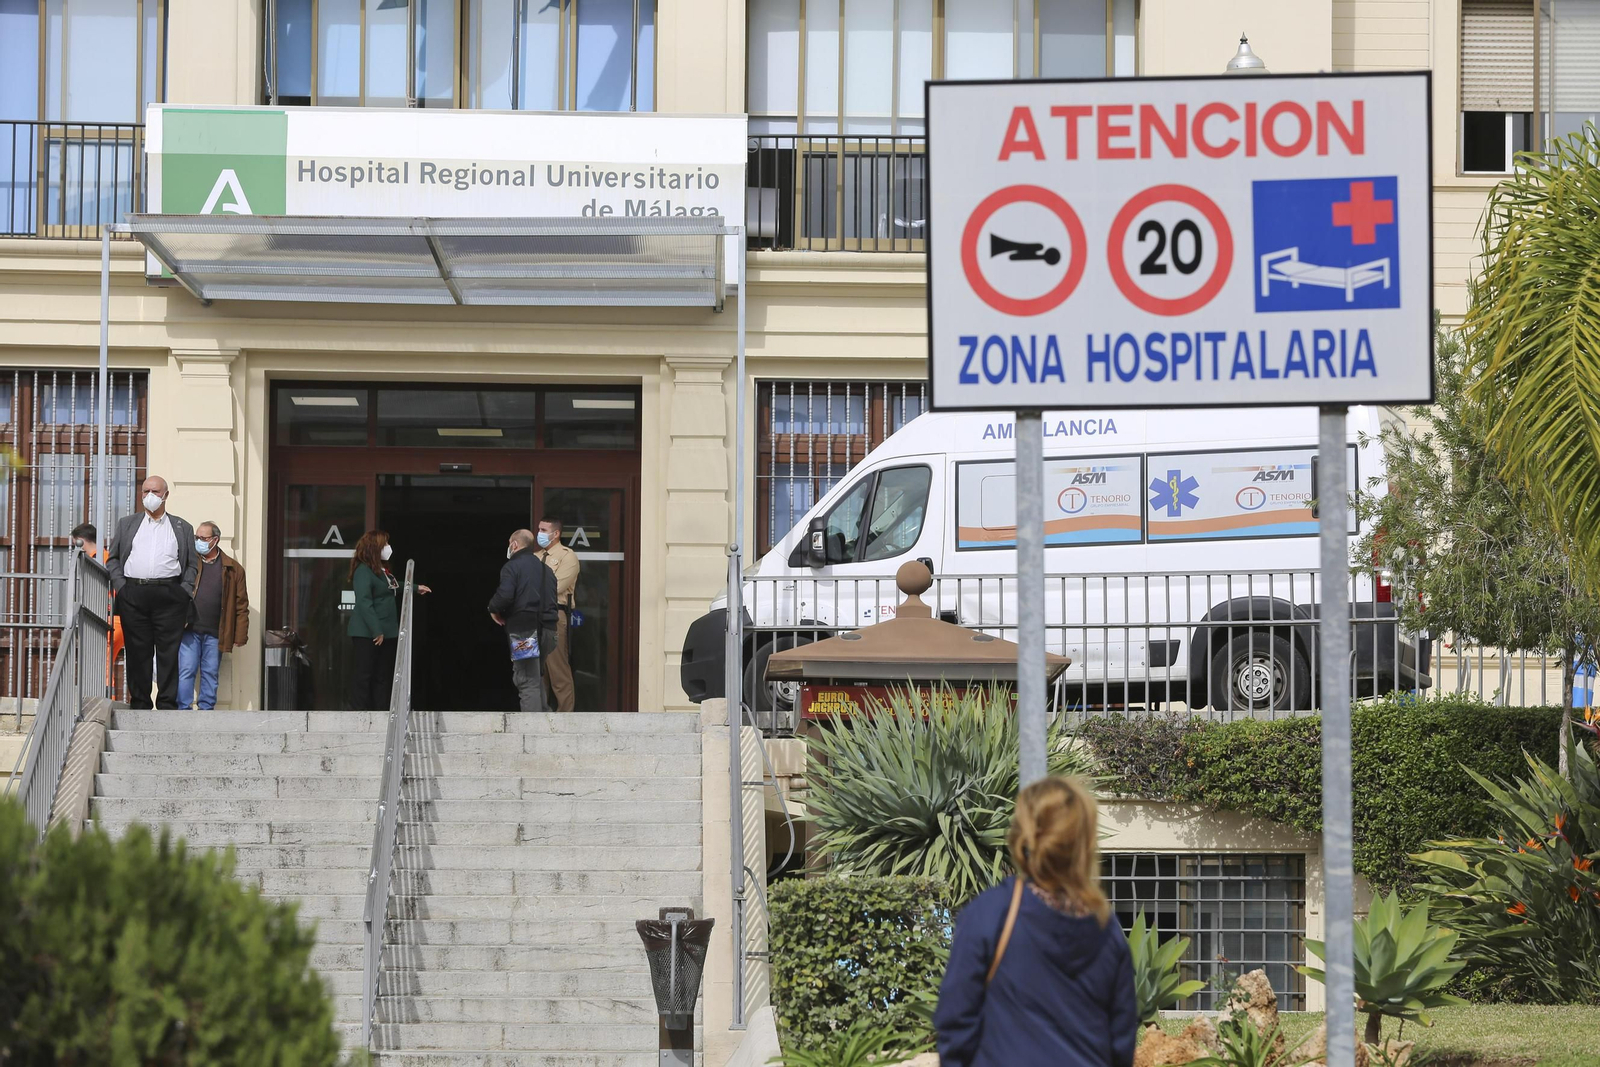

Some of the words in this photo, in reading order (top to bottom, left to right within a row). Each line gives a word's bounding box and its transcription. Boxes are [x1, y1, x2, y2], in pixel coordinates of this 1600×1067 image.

[997, 99, 1365, 161] ATENCION
[298, 160, 409, 188] Hospital
[420, 162, 535, 191] Regional
[547, 164, 720, 190] Universitario
[581, 198, 614, 217] de
[1137, 218, 1203, 276] 20
[958, 333, 1067, 385] ZONA
[1086, 328, 1378, 383] HOSPITALARIA
[982, 418, 1118, 440] AMLANCIA
[1071, 472, 1106, 484] ASM
[1252, 470, 1295, 482] ASM
[1090, 494, 1131, 504] TENORIO
[1270, 492, 1312, 501] TENORIO
